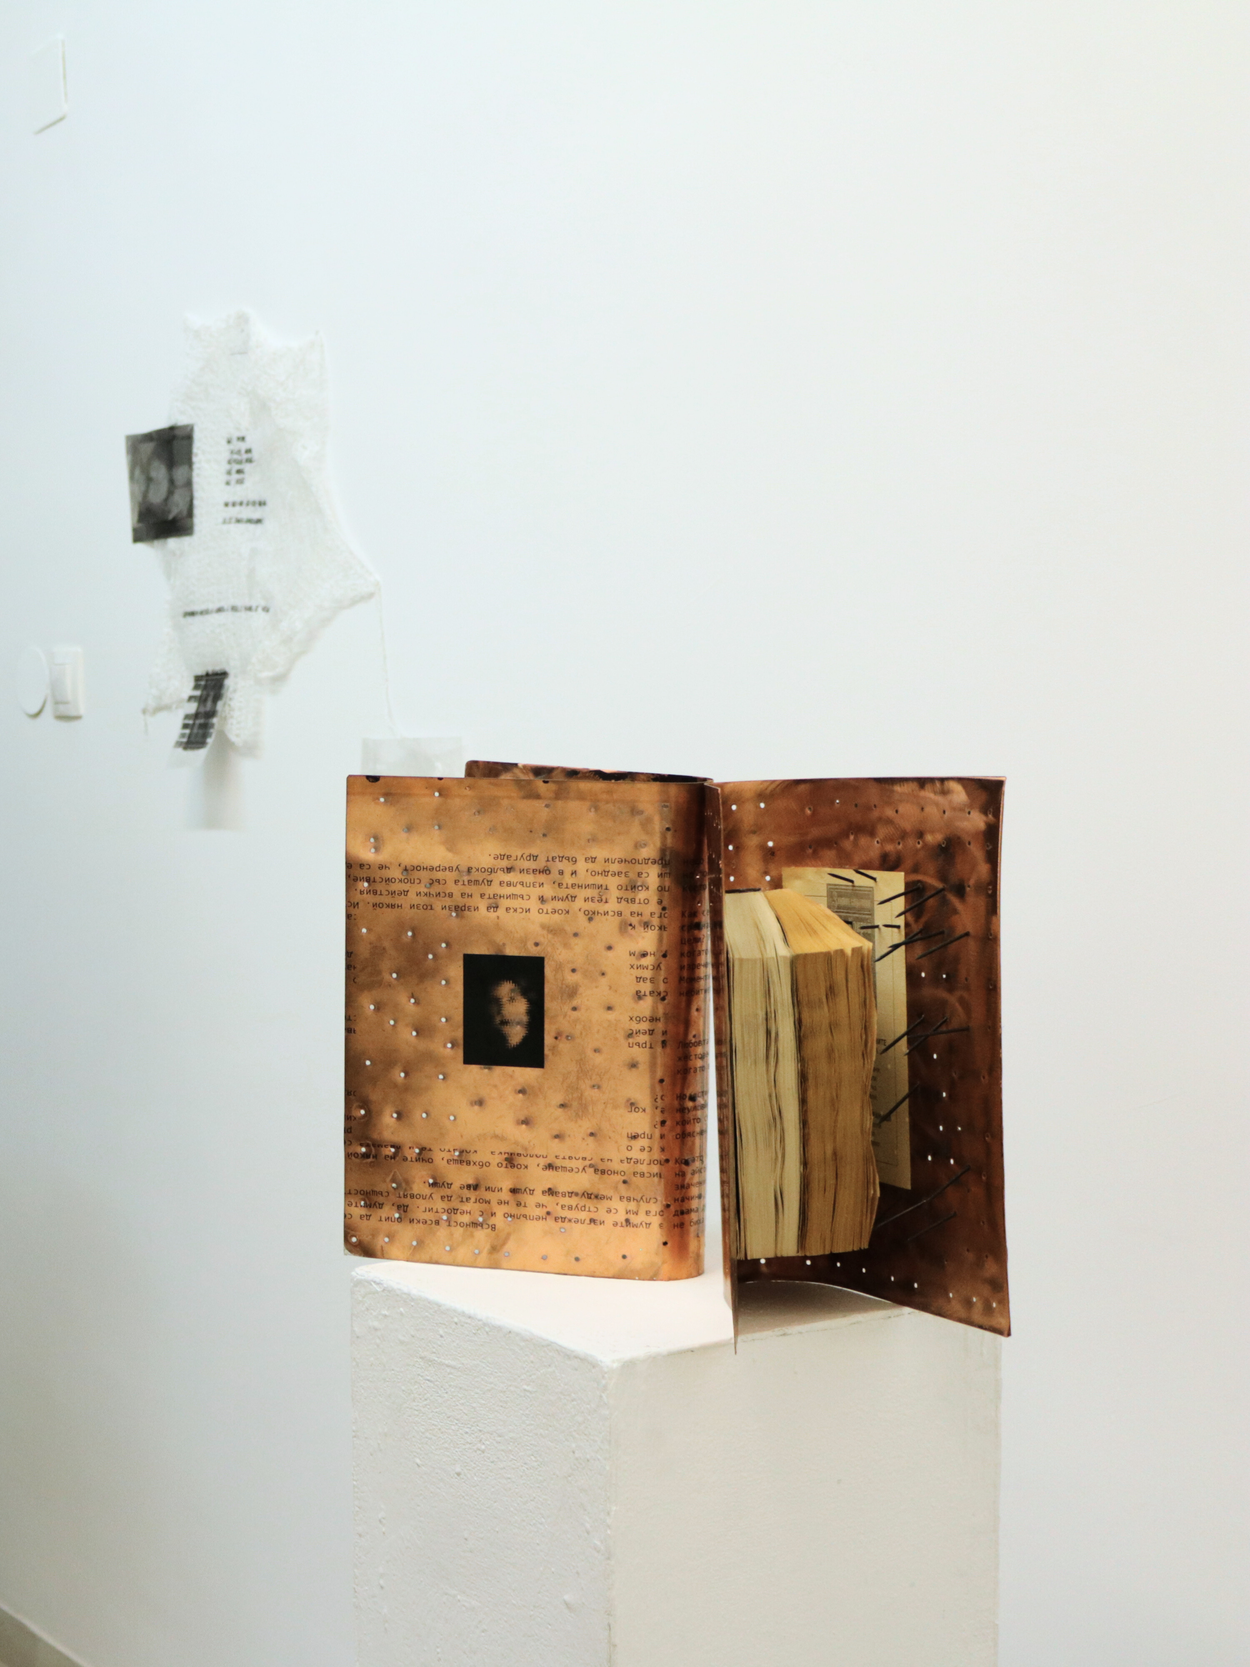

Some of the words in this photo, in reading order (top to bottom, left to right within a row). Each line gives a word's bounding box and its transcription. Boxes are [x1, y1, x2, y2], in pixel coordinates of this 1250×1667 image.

[545, 855, 577, 865] бъдат
[584, 856, 597, 864] да
[454, 878, 493, 887] душата
[499, 880, 544, 890] изпълва
[617, 884, 649, 893] който
[415, 890, 453, 898] всички
[551, 894, 577, 902] думи
[583, 896, 609, 904] тези
[616, 897, 649, 905] отвъд
[441, 903, 479, 912] изрази
[505, 907, 530, 915] иска
[537, 907, 570, 916] което
[402, 1155, 433, 1163] очите
[496, 1162, 528, 1170] което
[594, 1168, 626, 1177] онова
[397, 1192, 434, 1200] уловят
[542, 1189, 574, 1198] двама
[581, 1191, 612, 1201] между
[459, 1196, 491, 1204] могат
[619, 1195, 658, 1204] случва
[606, 1207, 618, 1215] се
[378, 1215, 402, 1223] опит
[503, 1212, 547, 1221] непълно
[554, 1215, 605, 1226] изглежда
[408, 1218, 440, 1226] всеки
[447, 1221, 496, 1231] Всъщност
[612, 1221, 651, 1229] думите
